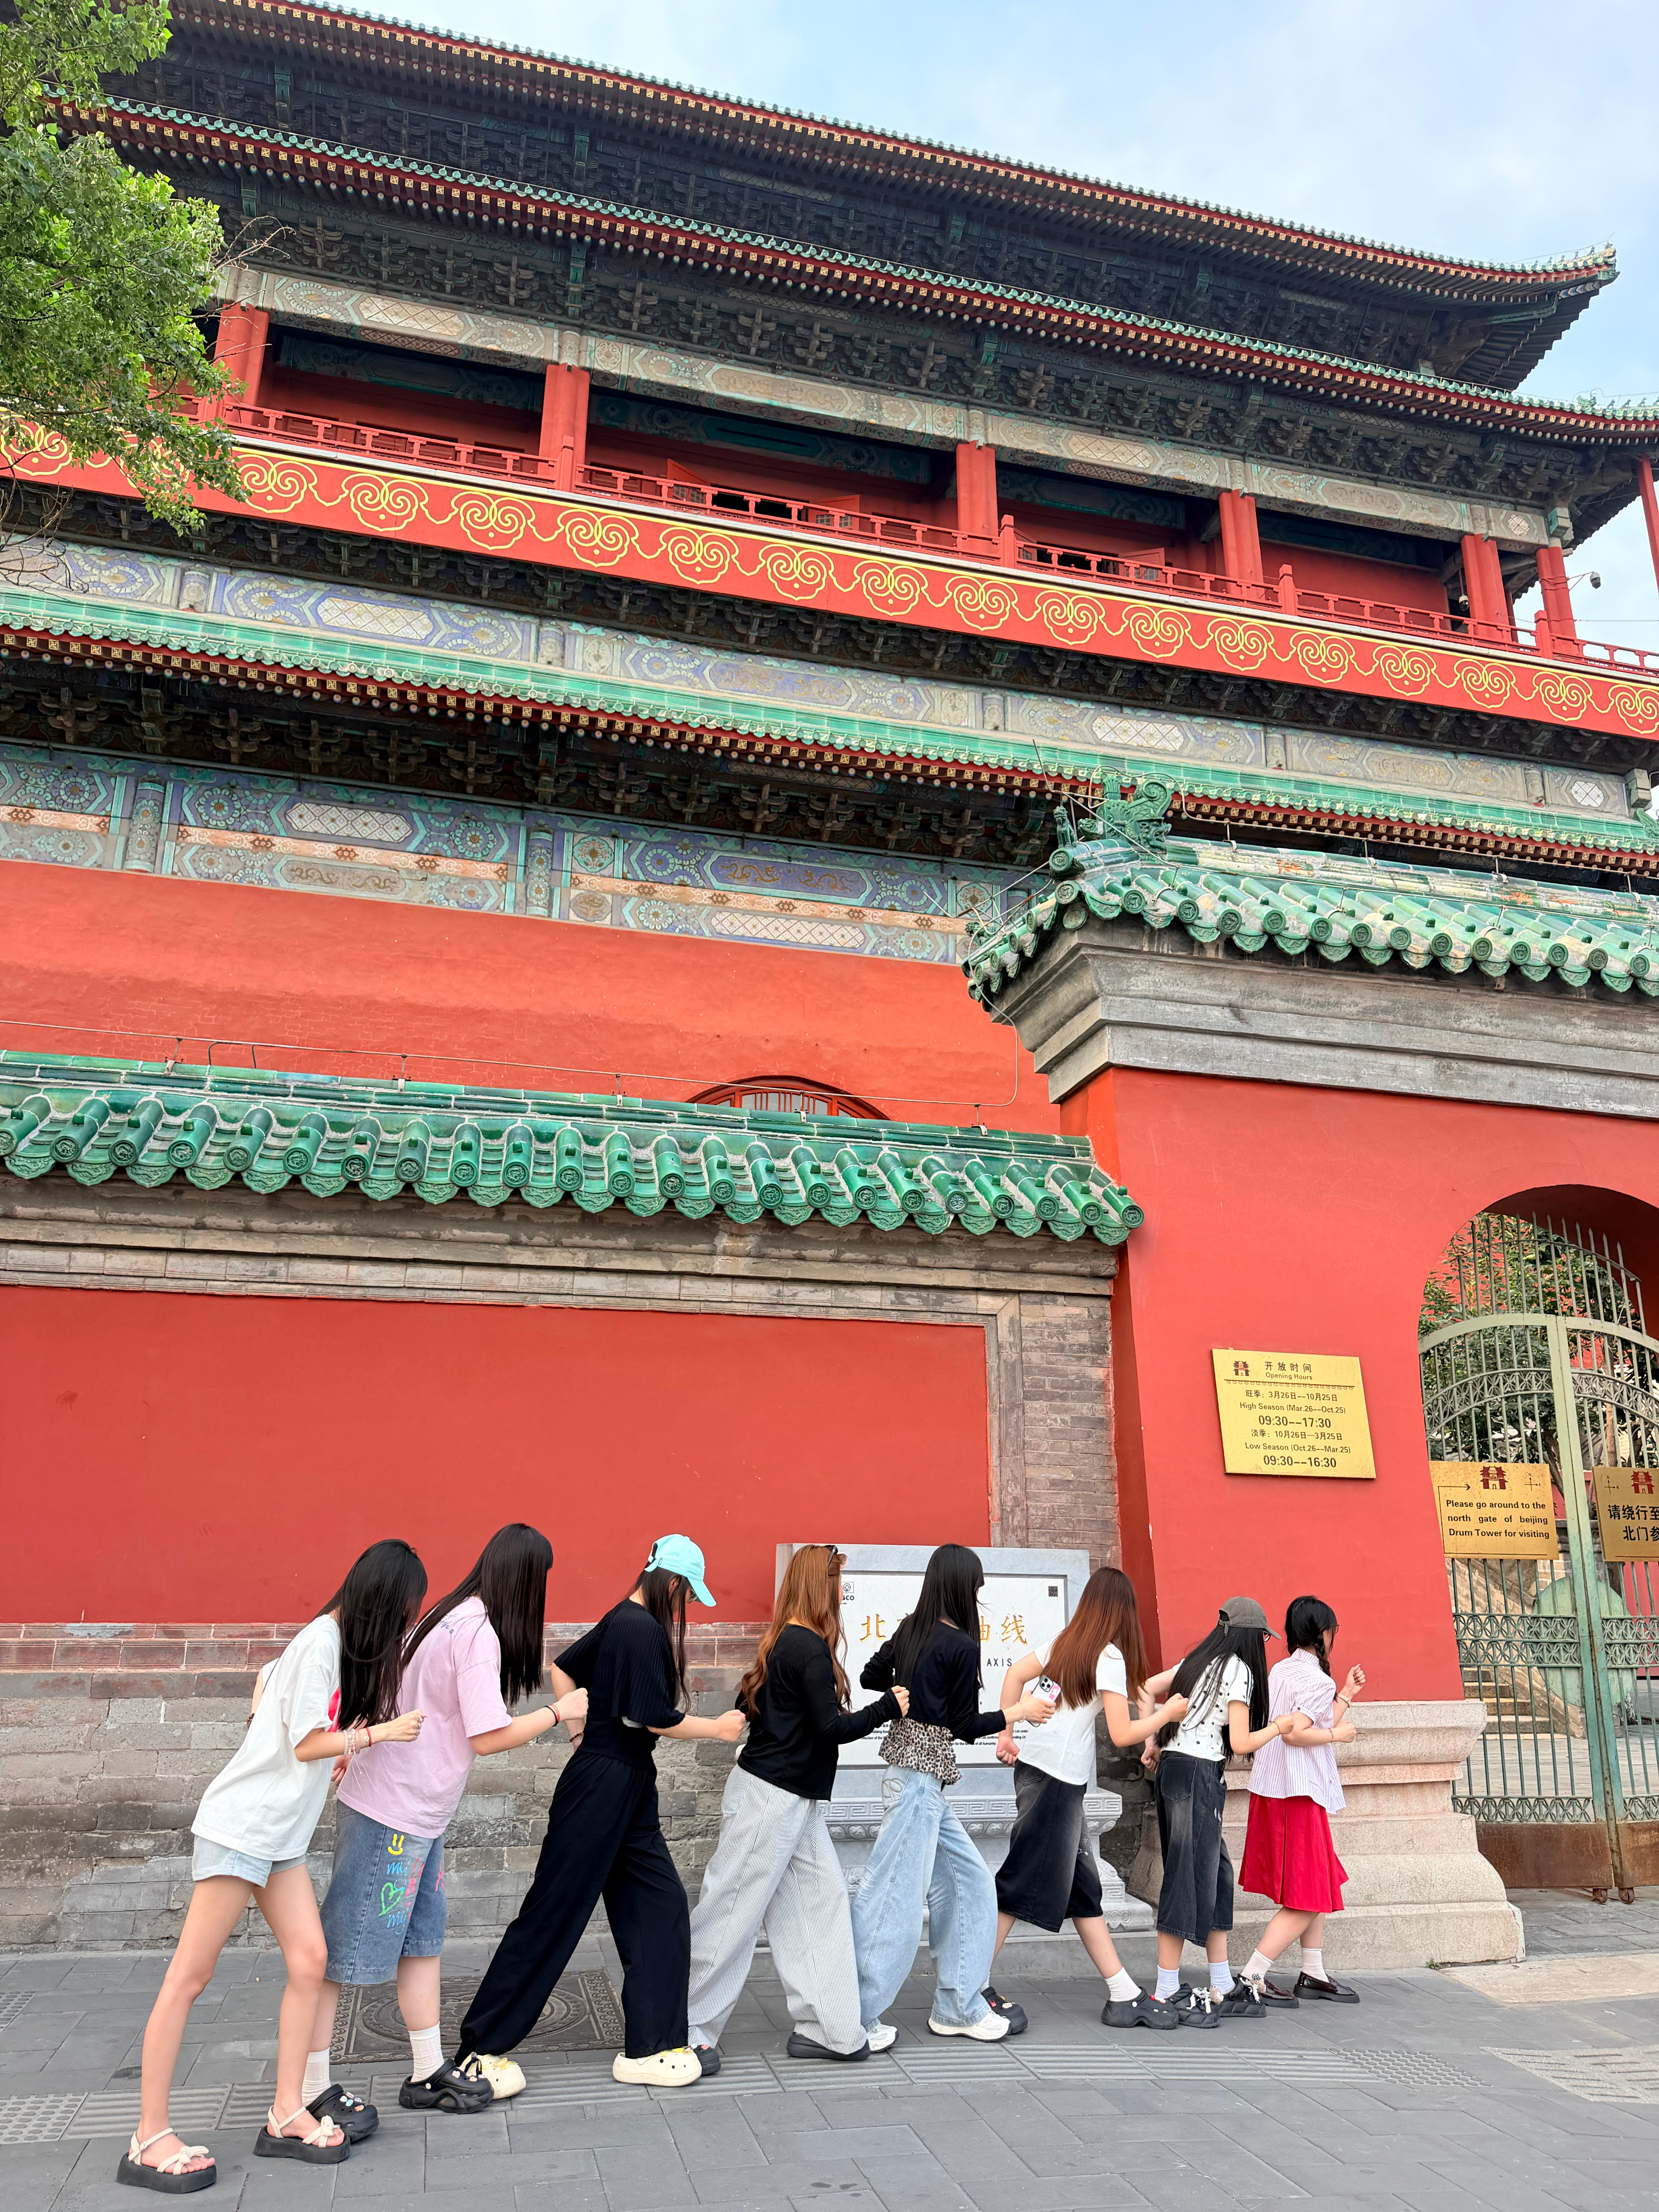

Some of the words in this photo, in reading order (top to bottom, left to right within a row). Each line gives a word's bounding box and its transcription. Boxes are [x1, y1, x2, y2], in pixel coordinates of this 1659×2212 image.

[1265, 1361, 1312, 1372] 开放时间
[1446, 1499, 1474, 1508] Please
[1489, 1501, 1519, 1509] around
[1608, 1504, 1659, 1520] 请绕行至
[1479, 1516, 1497, 1524] gate
[1520, 1516, 1548, 1525] beijing
[1449, 1528, 1473, 1537] Drum
[1475, 1529, 1502, 1537] Tower
[1504, 1529, 1517, 1537] for
[1519, 1530, 1550, 1539] visiting
[1623, 1525, 1659, 1541] 北门参
[987, 1658, 1012, 1667] AXIS
